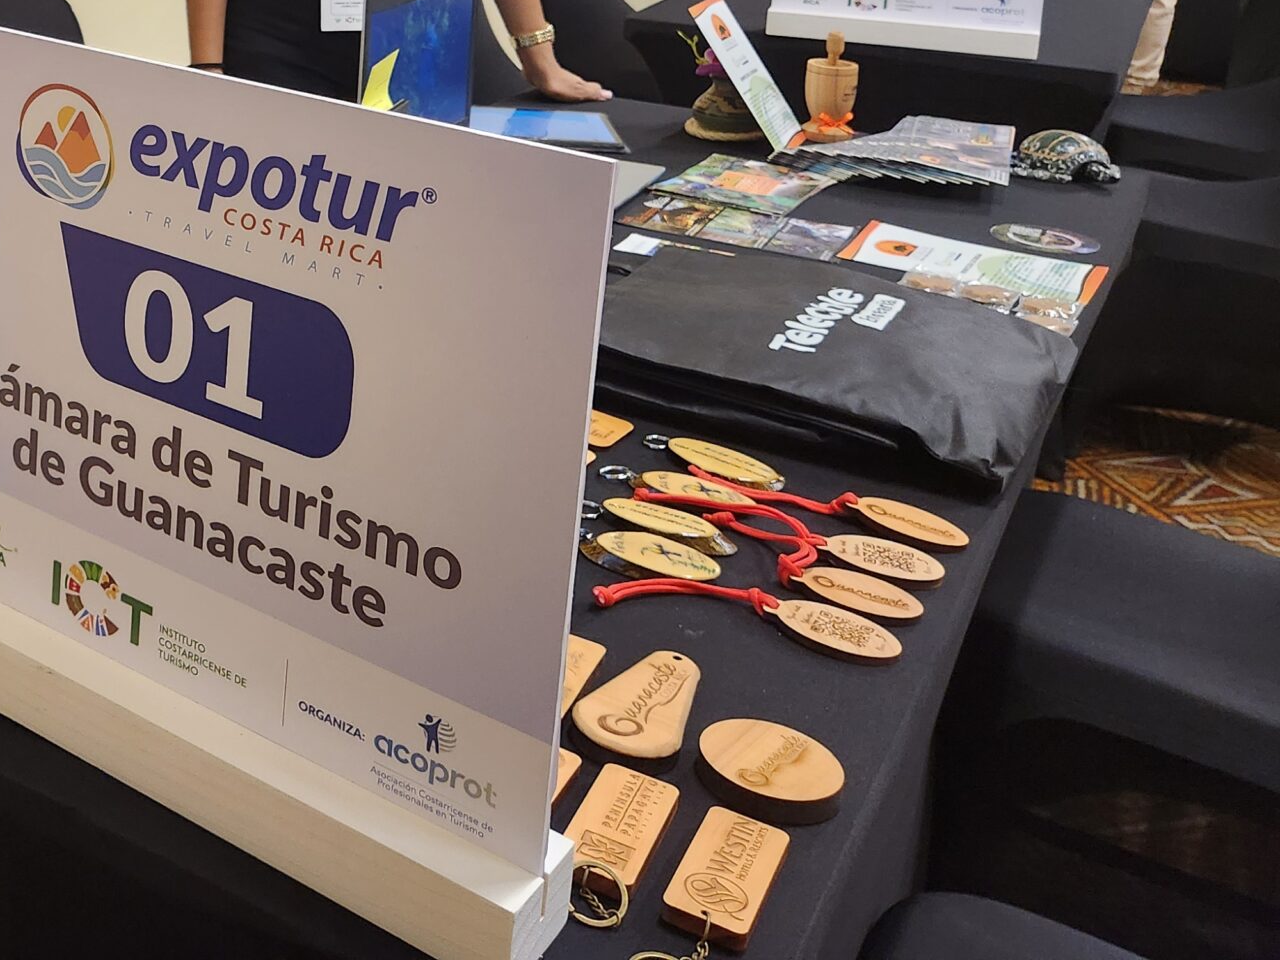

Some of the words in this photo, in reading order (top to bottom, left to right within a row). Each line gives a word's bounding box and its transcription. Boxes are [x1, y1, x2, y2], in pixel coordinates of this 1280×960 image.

[223, 208, 305, 247] COSTA
[320, 235, 383, 269] RICA
[124, 269, 263, 420] 01
[12, 428, 66, 486] de
[79, 455, 386, 629] Guanacaste
[151, 426, 213, 489] de
[227, 449, 463, 590] Turismo
[51, 560, 153, 646] ICT
[158, 636, 232, 681] COSTARRICENSE
[234, 673, 248, 689] DE
[158, 649, 199, 676] TURISMO
[159, 624, 206, 654] INSTITUTO
[298, 700, 366, 742] ORGANIZA:
[597, 662, 676, 737] Guanacaste
[370, 766, 417, 795] Asociación
[419, 790, 479, 826] Costarricense
[481, 822, 494, 833] de
[374, 734, 497, 809] acoprot
[602, 773, 641, 828] PENINSULA
[377, 778, 433, 813] Profesionales
[436, 809, 447, 819] en
[449, 813, 484, 838] Turismo
[620, 780, 658, 837] PAPAGAYO
[706, 816, 758, 873] WESTIN
[736, 857, 754, 881] HOTELS
[750, 826, 769, 852] RESORTS
